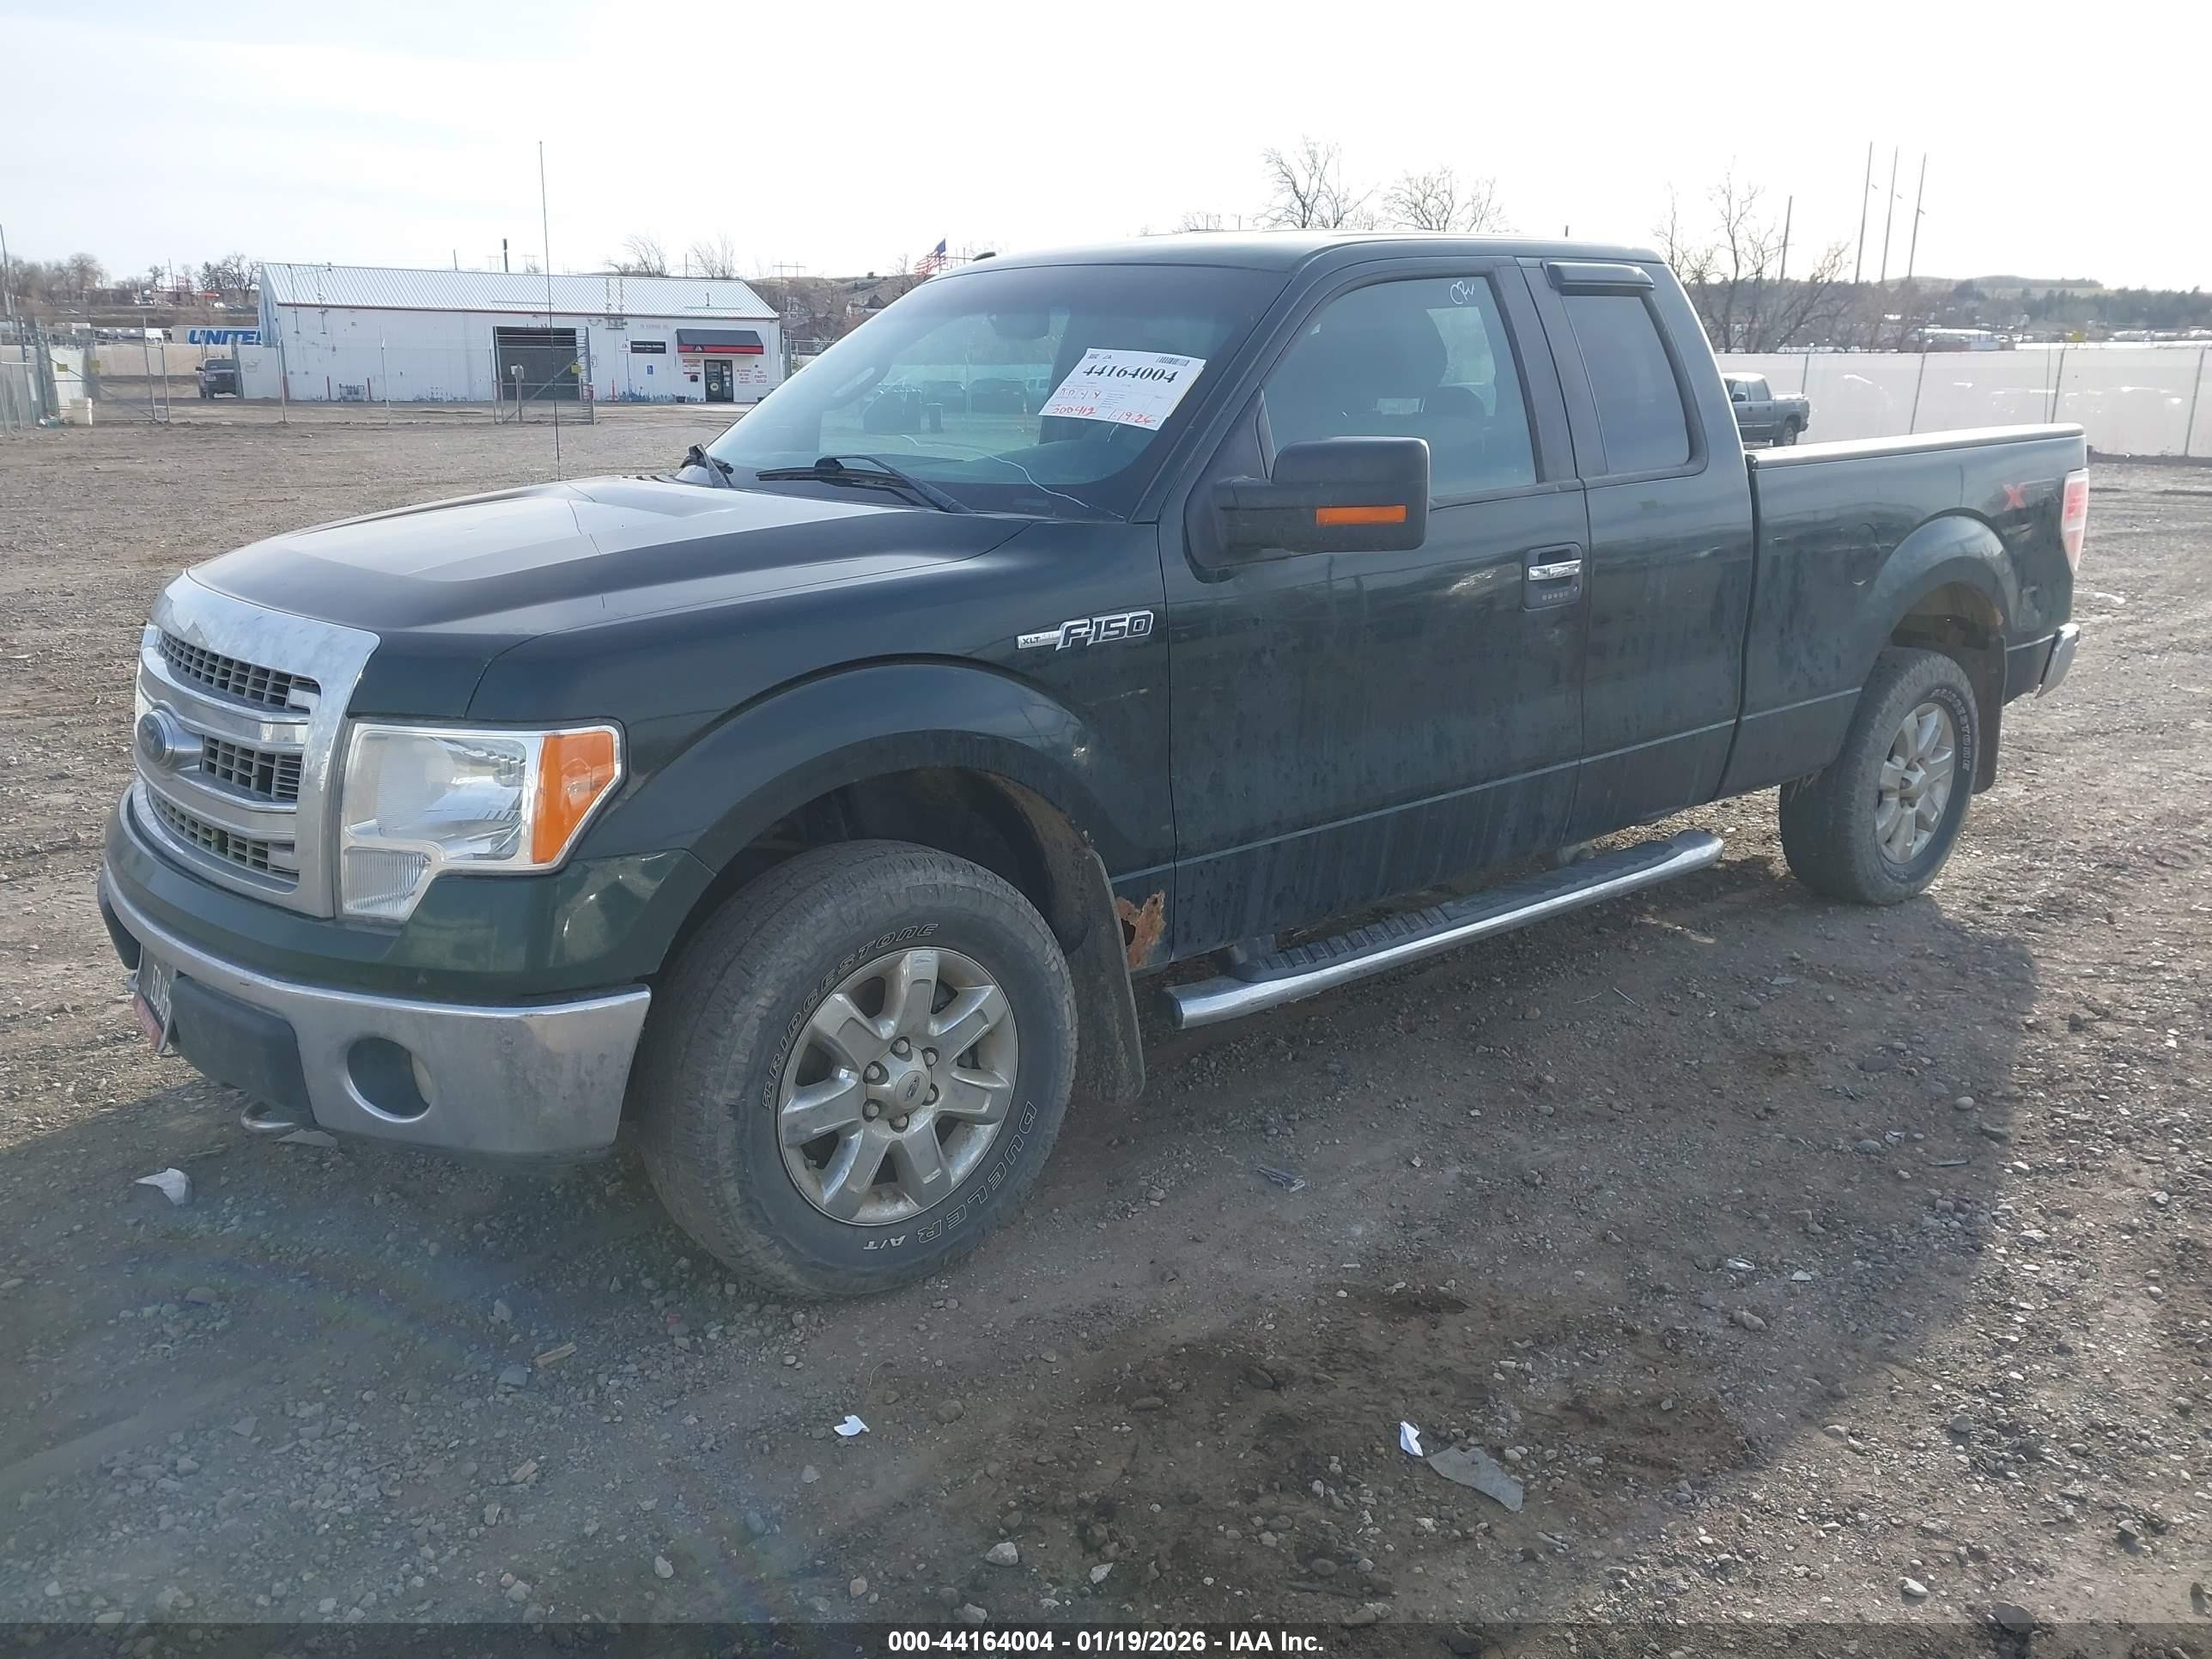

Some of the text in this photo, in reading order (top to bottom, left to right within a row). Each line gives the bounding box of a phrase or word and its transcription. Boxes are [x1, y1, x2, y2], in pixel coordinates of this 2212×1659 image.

[1083, 364, 1179, 384] 44164004
[1022, 636, 1041, 645] XLT
[763, 922, 939, 1110] BRIDGESTONE
[862, 1099, 1038, 1252] DUELER A/T
